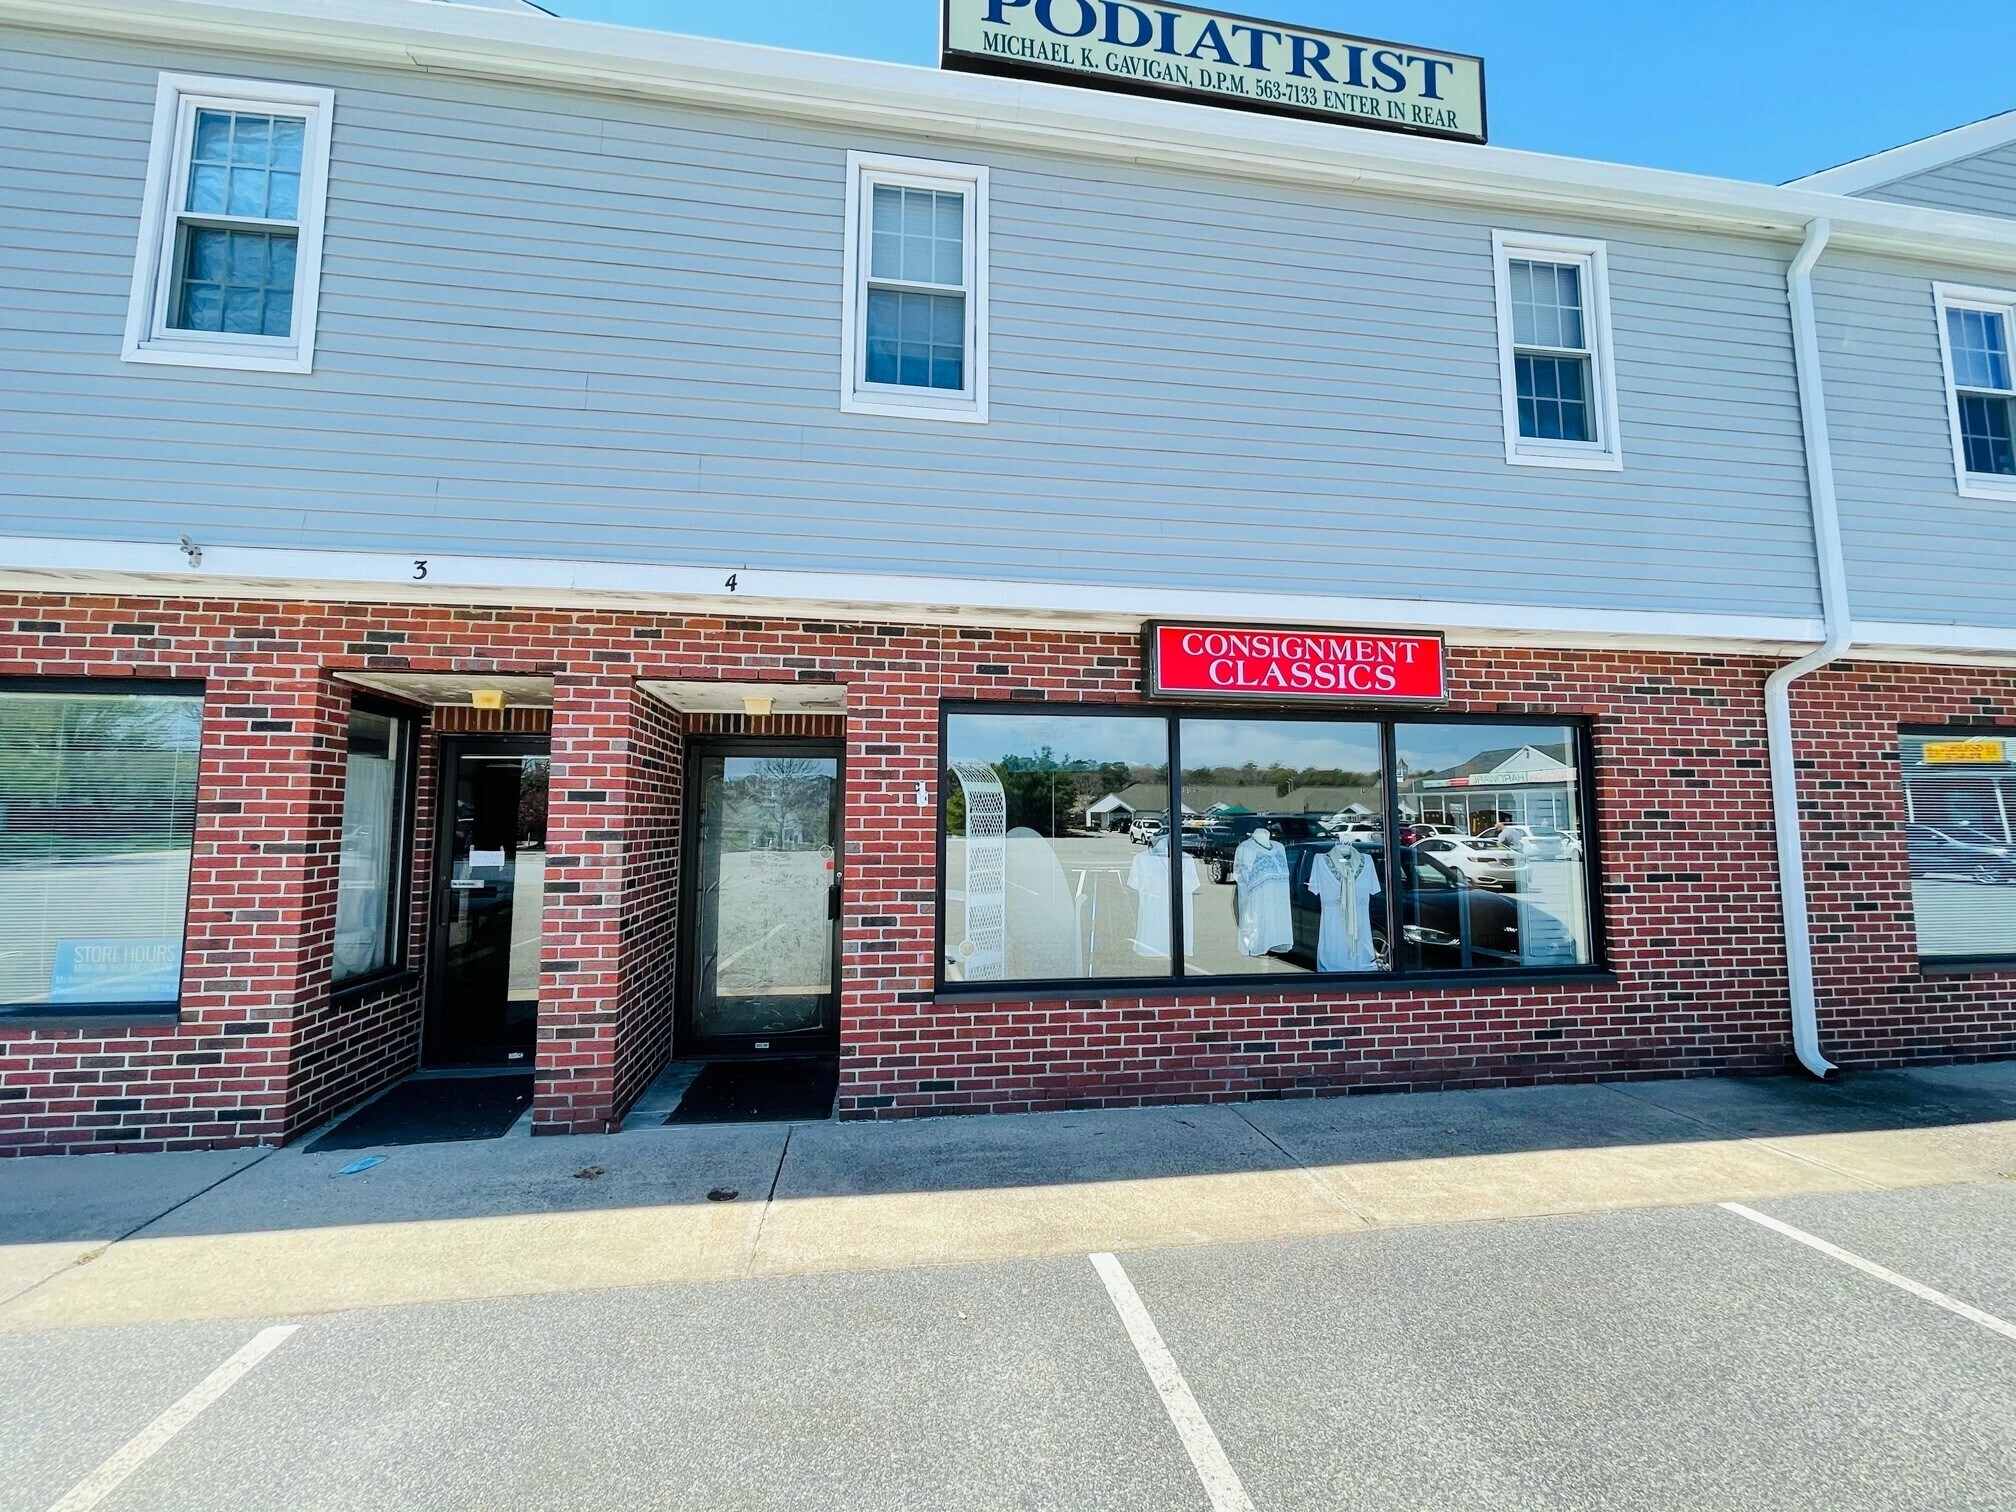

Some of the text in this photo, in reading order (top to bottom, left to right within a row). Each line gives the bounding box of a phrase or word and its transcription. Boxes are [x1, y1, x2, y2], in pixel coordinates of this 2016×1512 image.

[980, 0, 1453, 100] PODIATRIST
[982, 30, 1459, 129] MICHAEL K. GAVIGAN, D.P.M. 563-7133 ENTER IN REAR
[412, 560, 428, 580] 3
[725, 573, 738, 592] 4
[1181, 632, 1419, 664] CONSIGNMENT
[1208, 659, 1396, 691] CLASSICS
[74, 945, 176, 963] STORE HOURS
